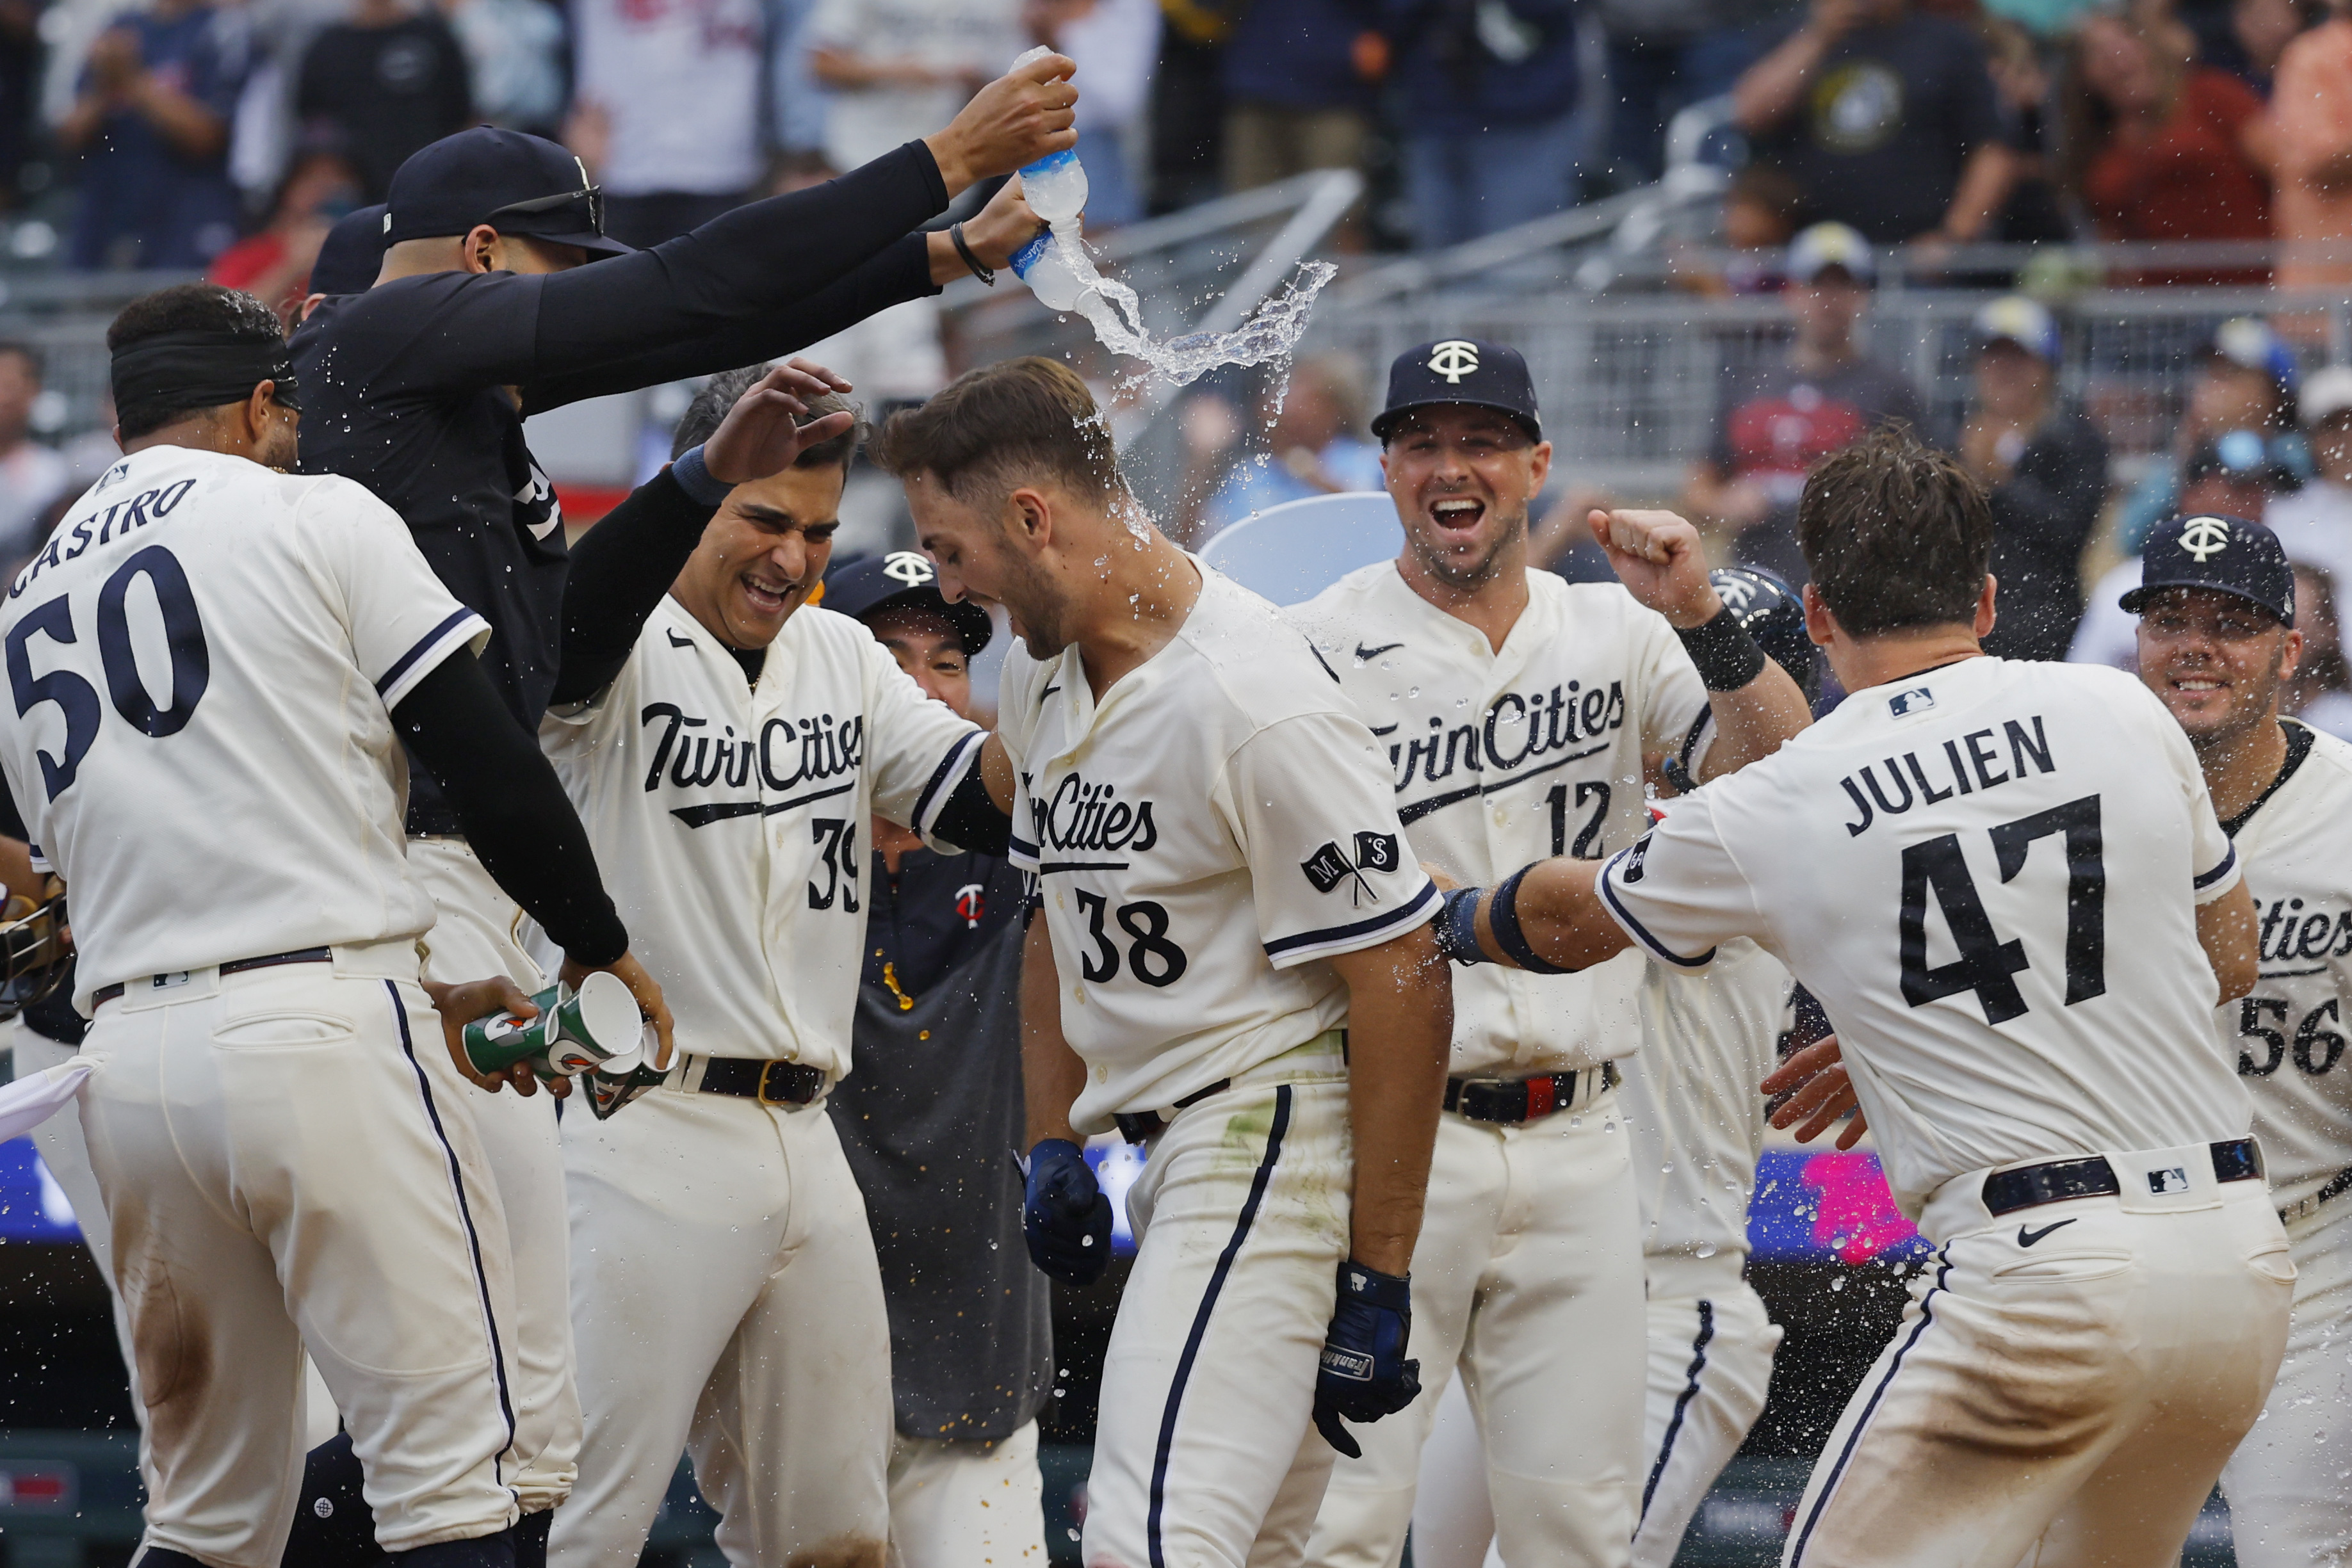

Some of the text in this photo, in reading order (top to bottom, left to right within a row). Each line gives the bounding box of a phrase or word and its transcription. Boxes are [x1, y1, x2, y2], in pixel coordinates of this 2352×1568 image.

[5, 545, 210, 805] 50
[759, 713, 863, 791] Cities
[1371, 679, 1625, 793] win Cities
[1839, 715, 2057, 838] JULIEN
[1048, 772, 1158, 853] Cities
[1545, 780, 1611, 861] 12
[808, 818, 860, 914] 39
[1899, 793, 2107, 1026] 47
[1075, 886, 1188, 987] 38
[2253, 898, 2352, 961] ties
[2237, 998, 2346, 1077] 56
